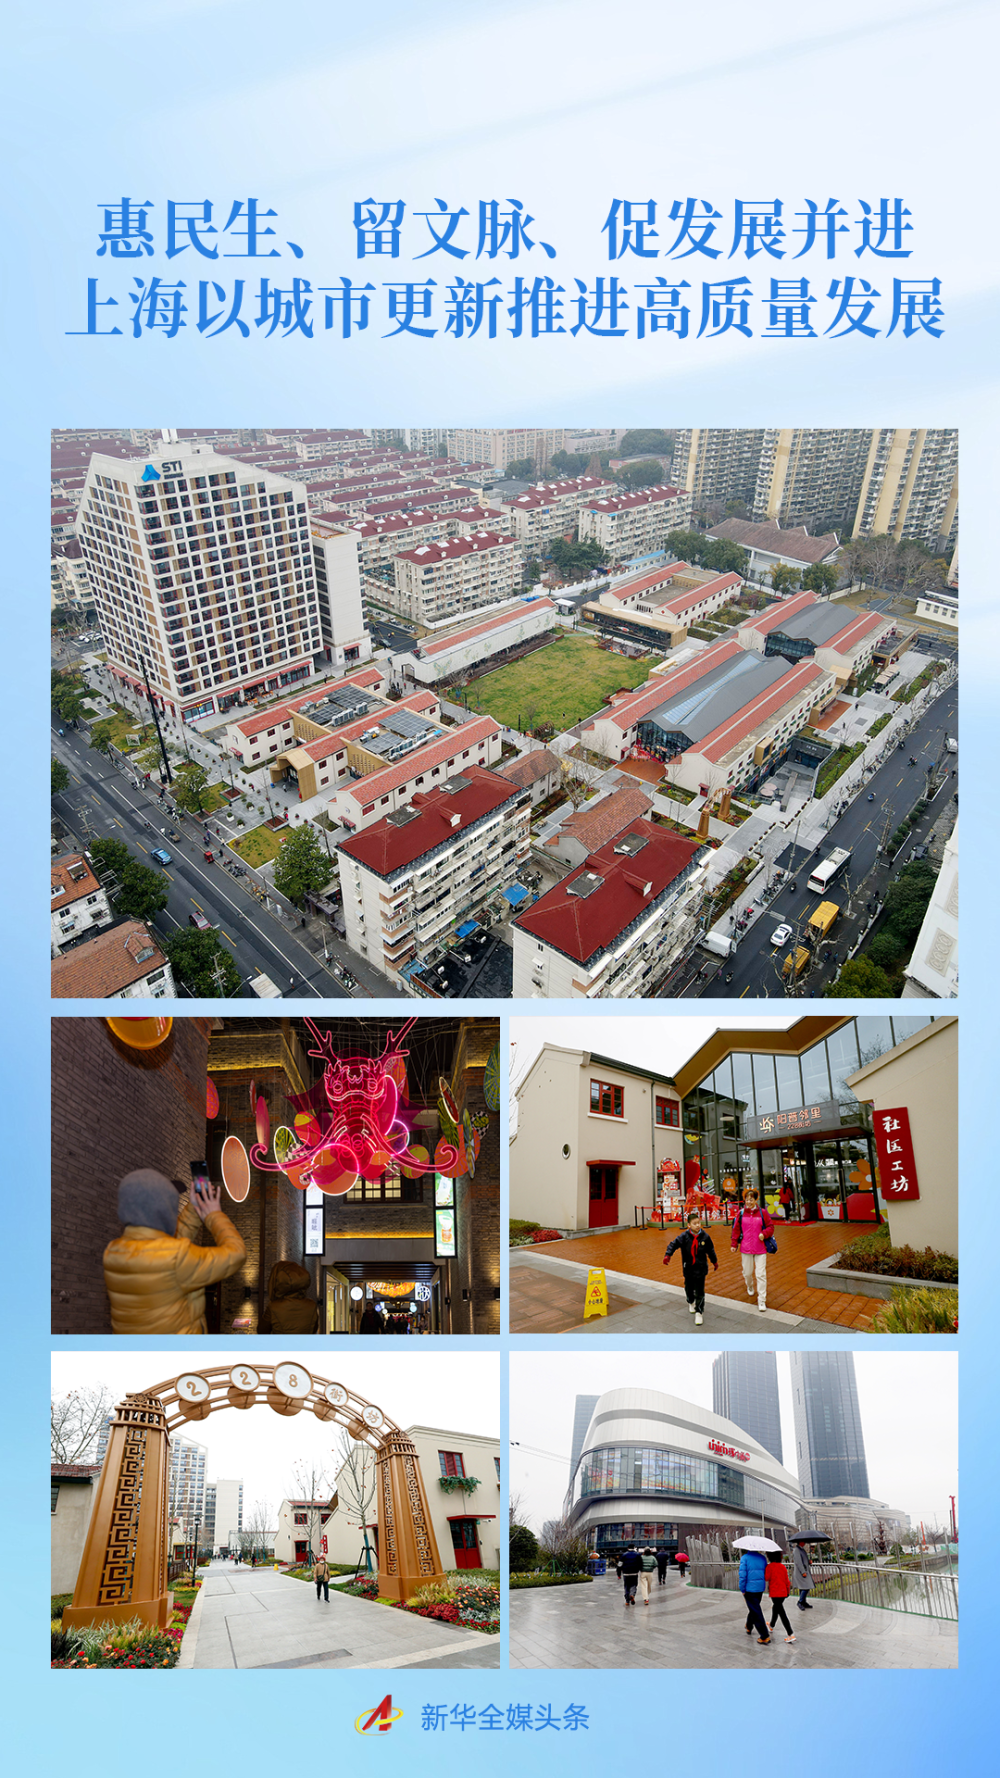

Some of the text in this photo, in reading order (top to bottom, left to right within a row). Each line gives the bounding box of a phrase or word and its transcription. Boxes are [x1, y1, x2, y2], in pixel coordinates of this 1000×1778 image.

[161, 460, 182, 473] STI
[882, 1115, 909, 1193] 社区工坊
